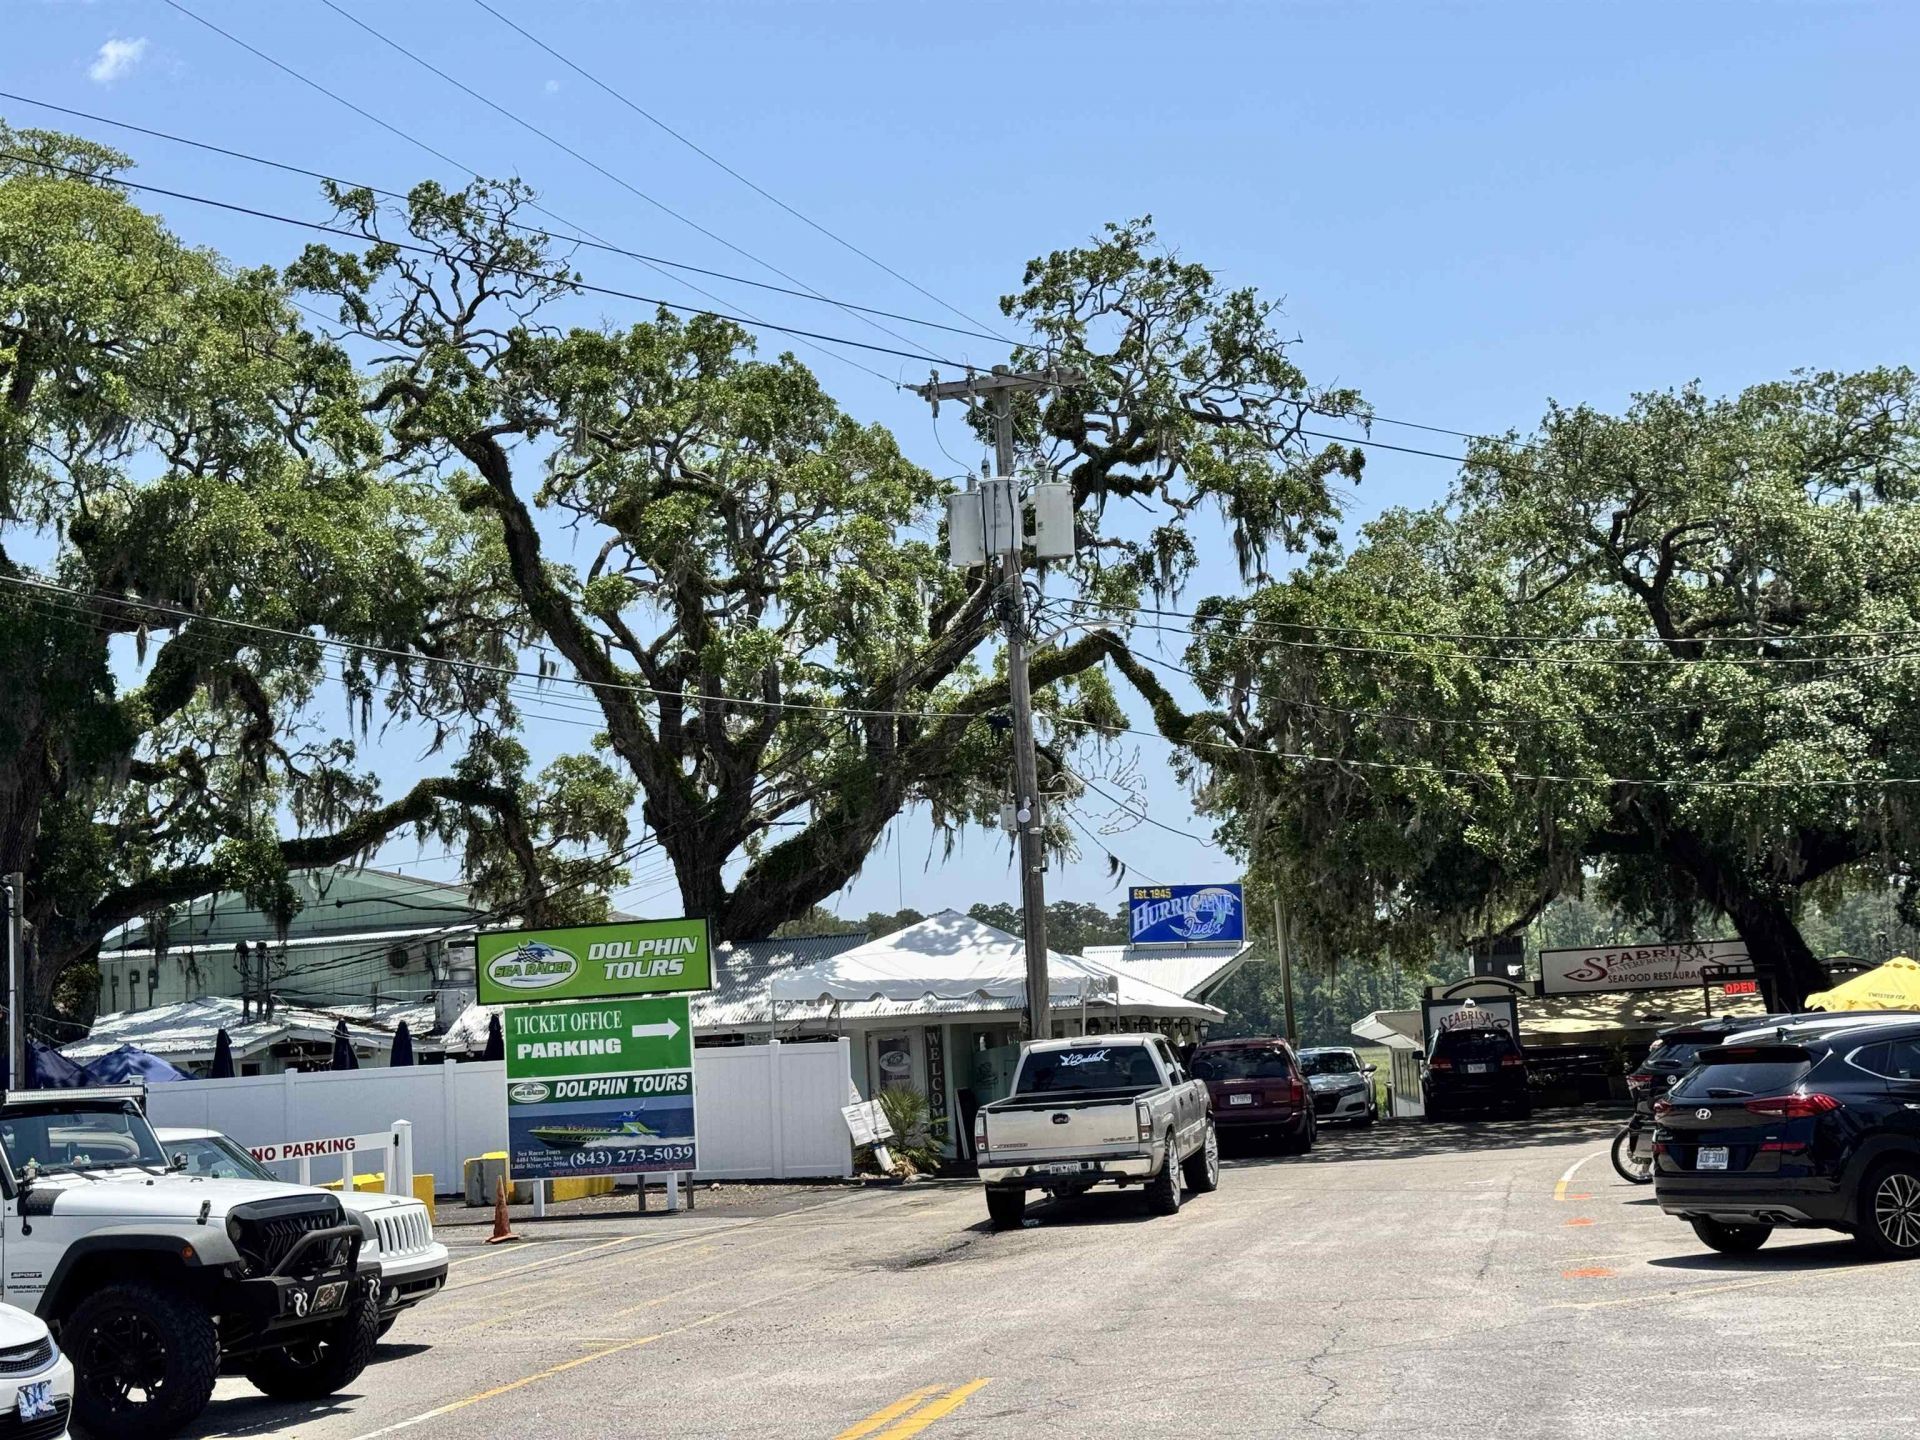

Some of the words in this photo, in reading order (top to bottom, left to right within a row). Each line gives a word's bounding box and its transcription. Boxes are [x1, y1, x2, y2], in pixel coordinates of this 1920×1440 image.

[1150, 888, 1171, 899] 1945
[1131, 893, 1235, 939] HURRICANE
[588, 937, 698, 961] DOLPHIN
[494, 965, 522, 977] SEA
[525, 961, 572, 975] RACER
[604, 958, 686, 980] TOURS
[1608, 973, 1651, 984] SEAFOOD
[1653, 970, 1703, 981] RESTAURAN
[1725, 982, 1755, 994] OPEN
[514, 1013, 568, 1035] TICKET
[570, 1010, 623, 1032] OFFICE
[517, 1038, 622, 1060] PARKING
[555, 1078, 628, 1098] DOLPHIN
[632, 1074, 688, 1093] TOURS
[926, 1032, 946, 1136] WELCOME
[251, 1146, 277, 1162] NO
[283, 1137, 356, 1158] PARKING
[570, 1150, 613, 1168] (843)
[617, 1145, 693, 1163] 273-5039
